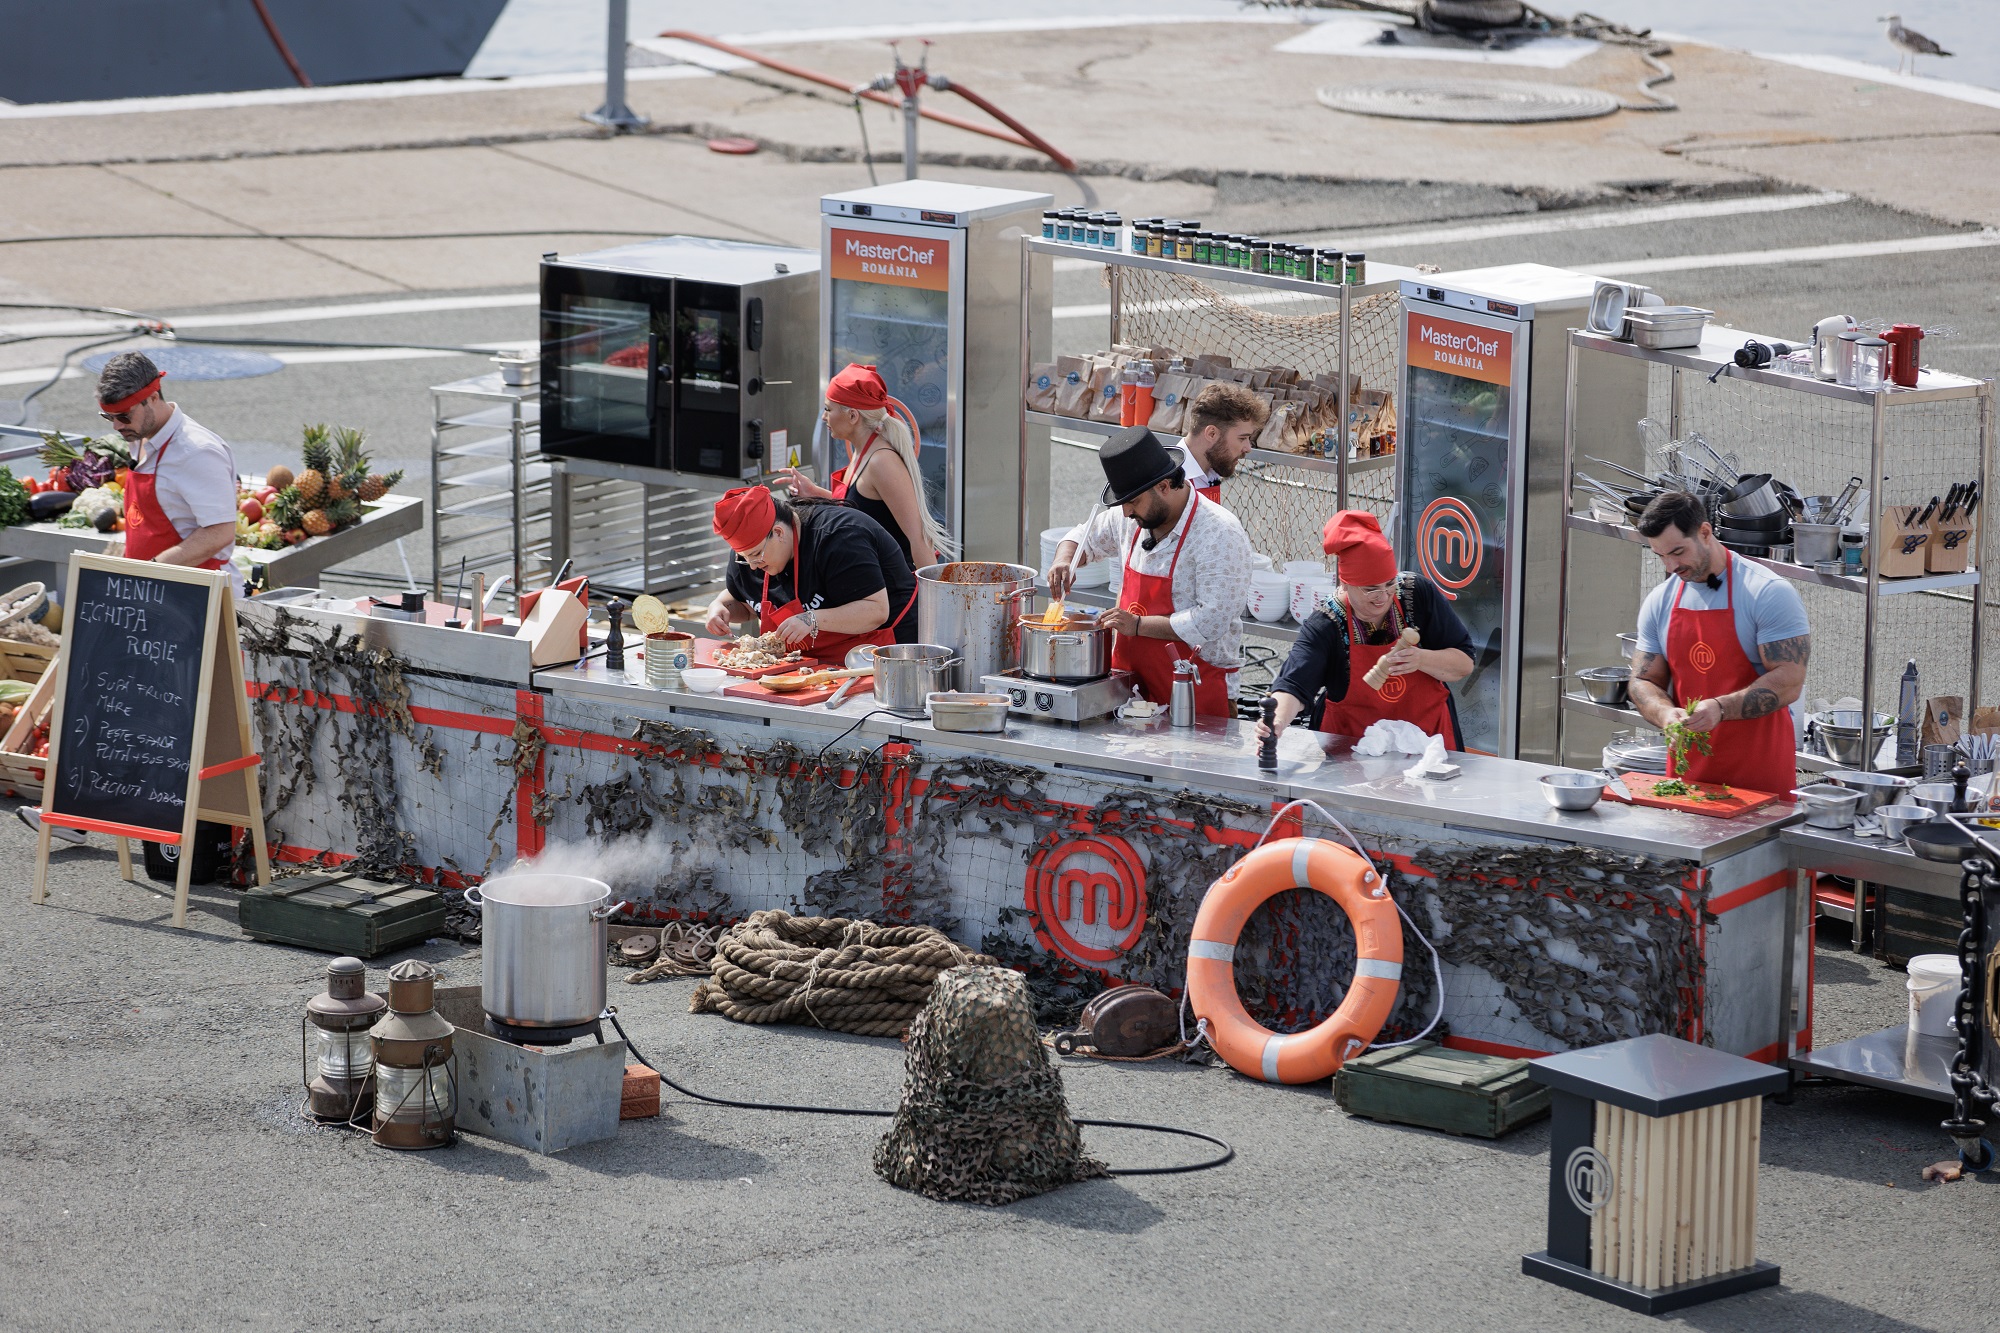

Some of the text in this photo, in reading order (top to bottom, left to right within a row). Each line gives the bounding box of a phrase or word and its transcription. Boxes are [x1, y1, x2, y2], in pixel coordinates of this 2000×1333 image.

[845, 238, 935, 265] MasterChef
[861, 261, 918, 279] ROMÂNIA
[1420, 324, 1499, 357] MasterChef
[1434, 350, 1484, 371] ROMÂNIA
[105, 576, 166, 605] MENIU
[79, 600, 148, 632] ECHIPA
[126, 635, 178, 665] ROȘIE
[96, 694, 134, 717] MARE
[74, 714, 90, 748] 2)
